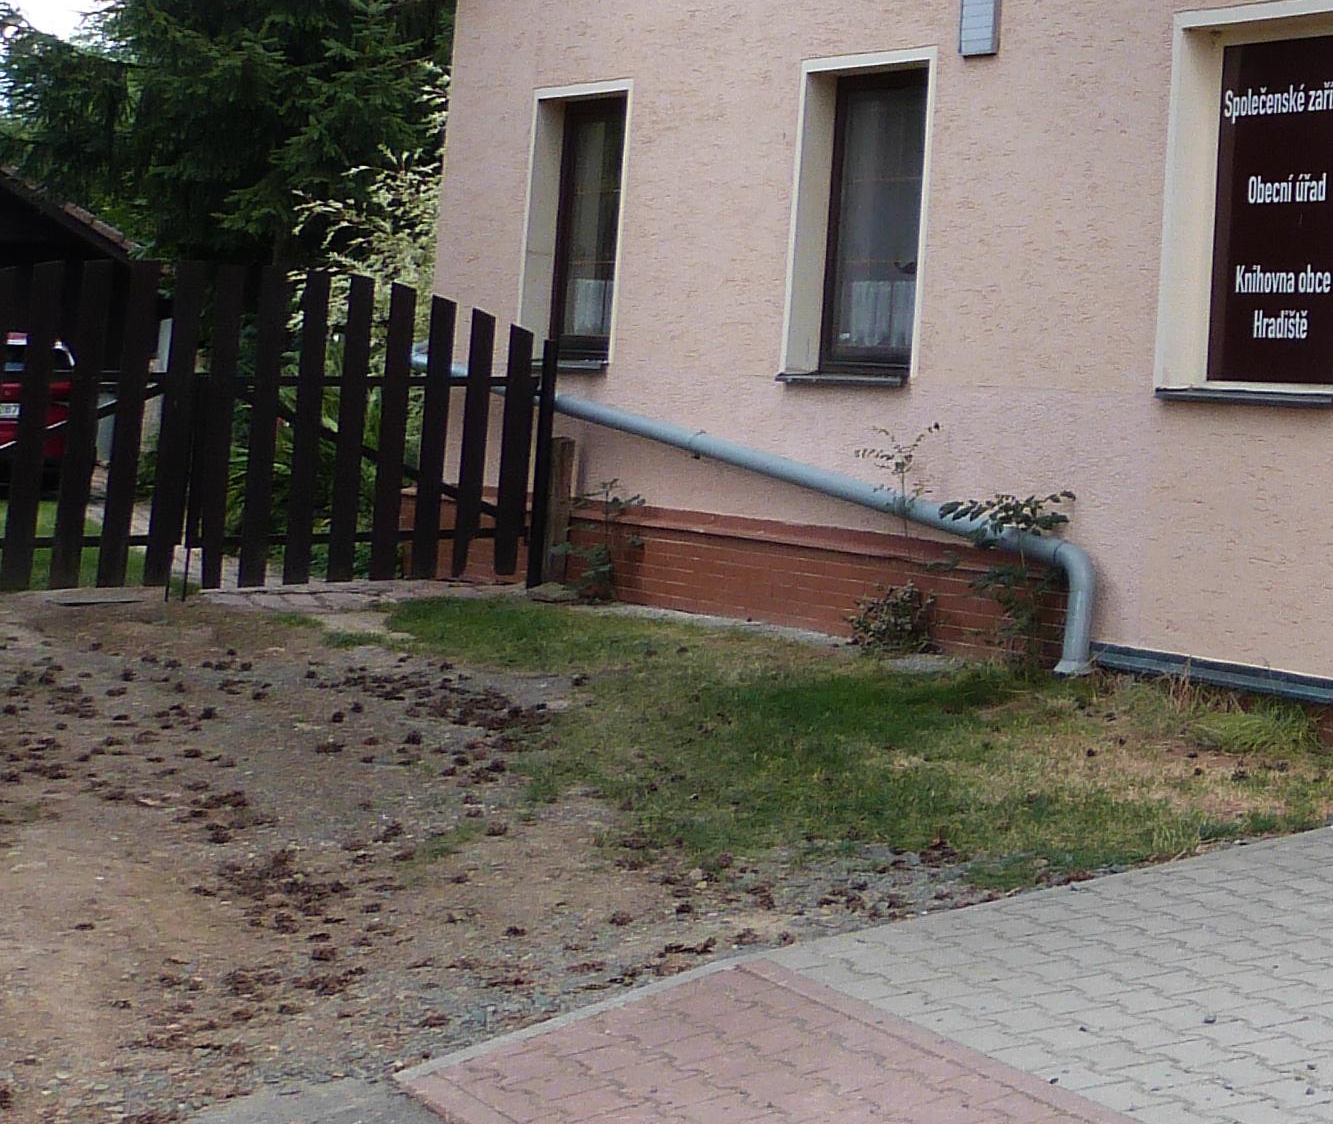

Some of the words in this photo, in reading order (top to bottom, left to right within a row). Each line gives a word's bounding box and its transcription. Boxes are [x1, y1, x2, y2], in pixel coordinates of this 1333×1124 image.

[1224, 83, 1305, 124] Společenské
[1248, 174, 1294, 204] Obecní
[1295, 172, 1327, 202] úřad
[1235, 265, 1295, 293] Knihovna
[1298, 264, 1332, 293] obce
[1253, 310, 1308, 339] Hradiště
